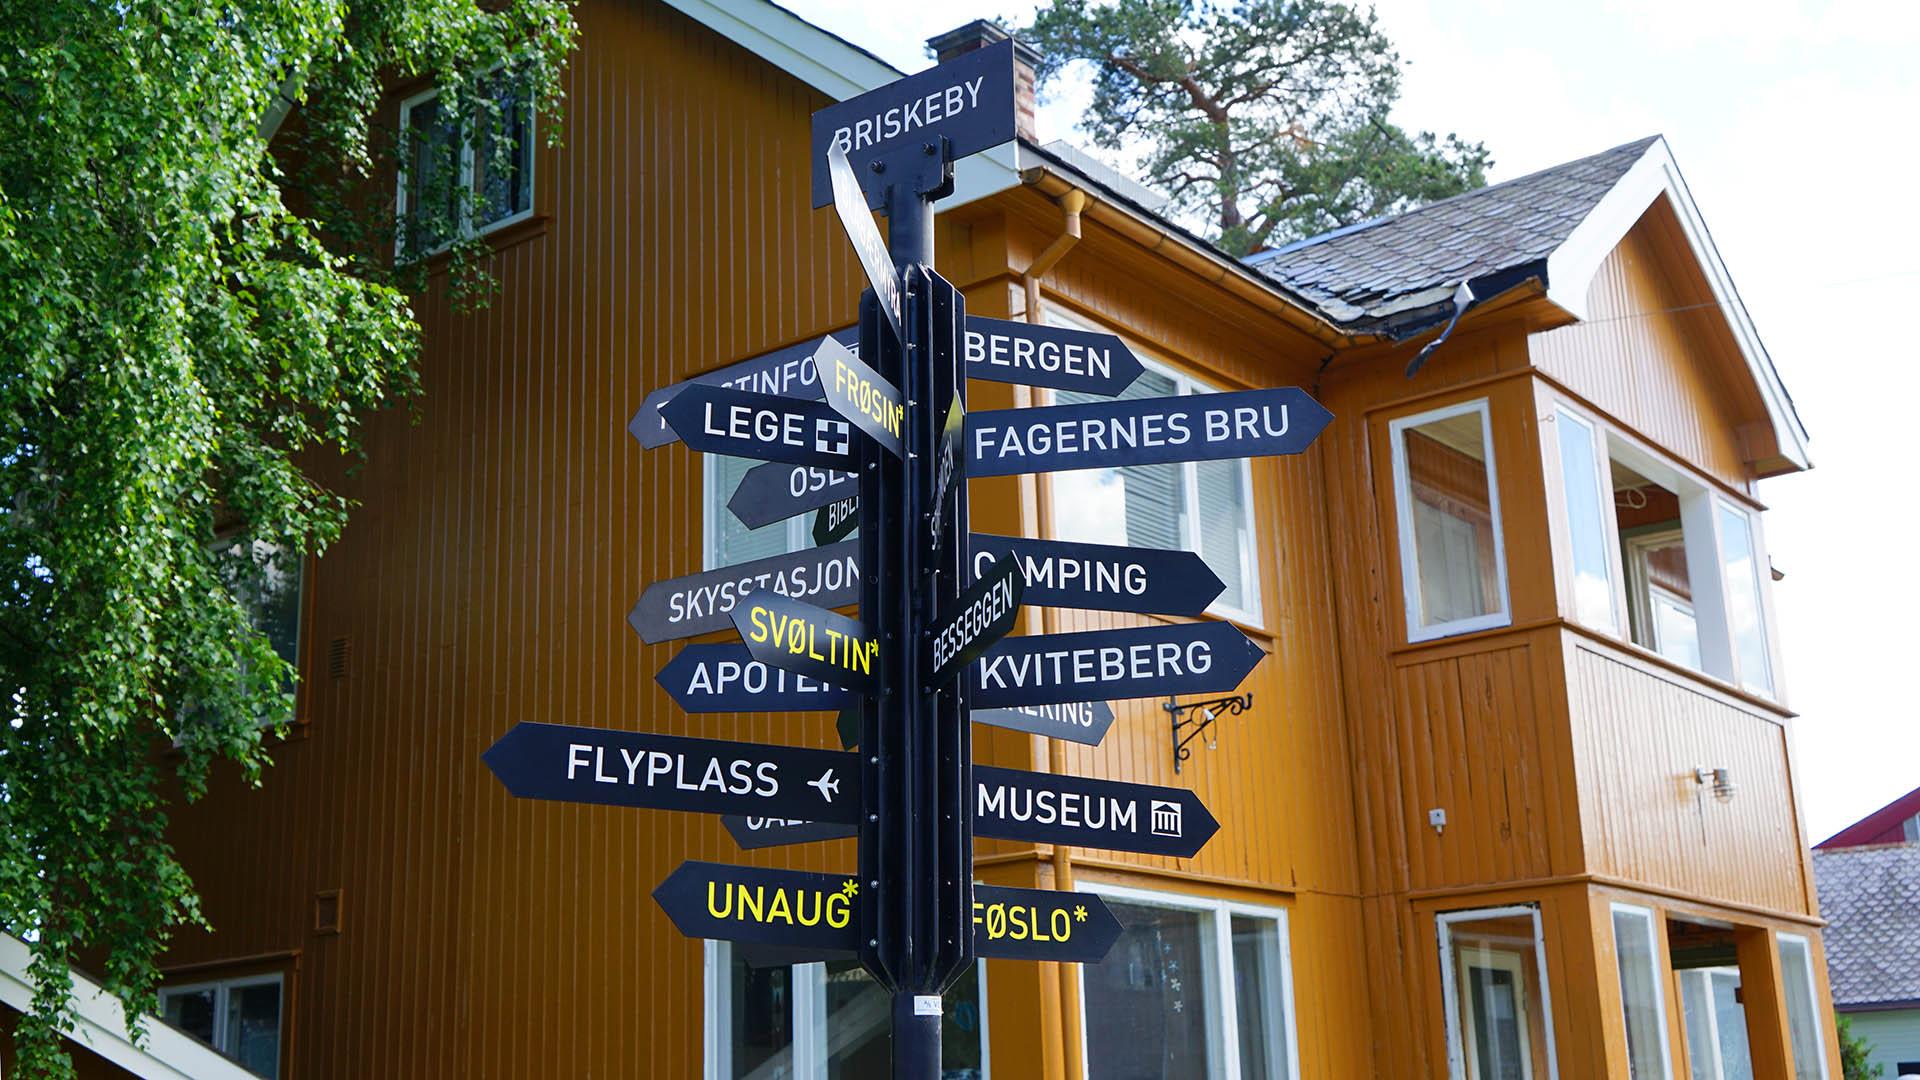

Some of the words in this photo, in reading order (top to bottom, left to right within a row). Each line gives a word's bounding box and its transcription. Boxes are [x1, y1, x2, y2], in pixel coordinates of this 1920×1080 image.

[833, 76, 984, 154] BRISKEBY
[965, 331, 1111, 379] BERGEN
[704, 402, 805, 447] LEGE
[974, 413, 1190, 460] FAGERNES
[1205, 405, 1290, 442] BRU
[974, 552, 1148, 595] CMPING
[933, 572, 1014, 674] BESSEGGEN
[980, 641, 1212, 690] KVITEBERG
[567, 744, 780, 798] FLYPLASS
[977, 783, 1137, 833] MUSEUM
